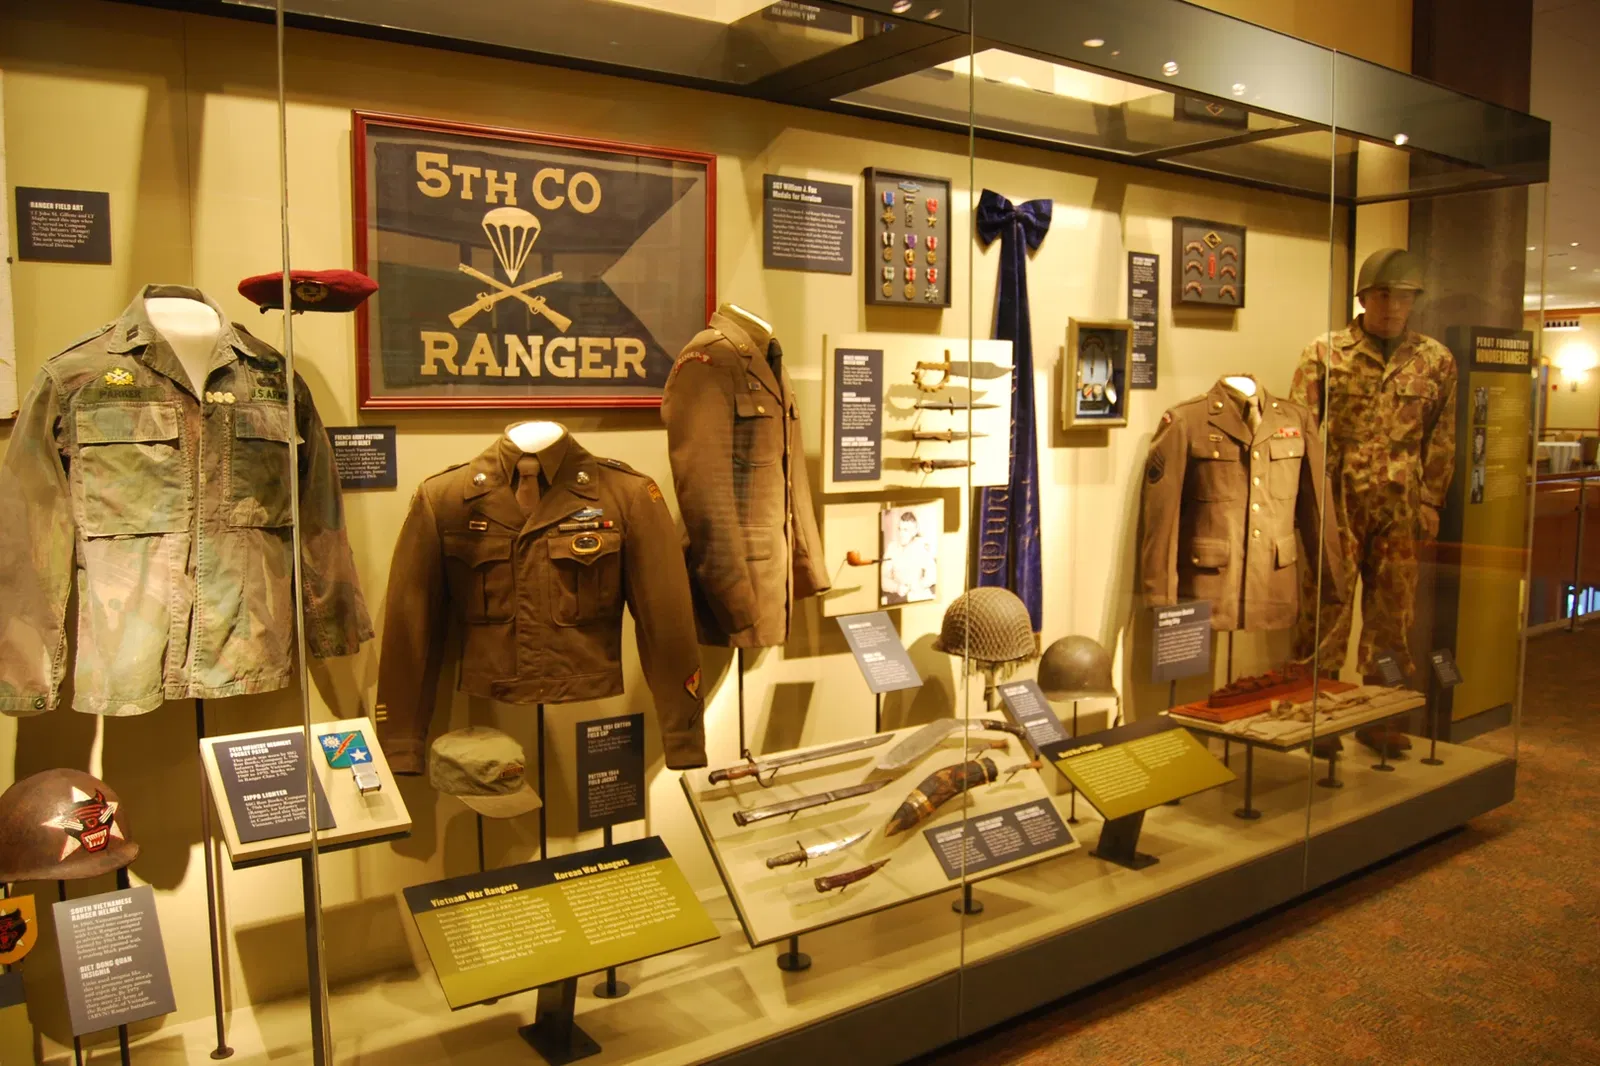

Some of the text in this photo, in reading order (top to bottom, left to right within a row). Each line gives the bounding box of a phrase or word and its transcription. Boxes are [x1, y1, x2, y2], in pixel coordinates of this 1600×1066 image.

[416, 151, 602, 214] 5TH CO
[420, 331, 647, 379] RANGER
[262, 790, 288, 798] LIGHTER
[554, 858, 631, 880] Korean War Rangers
[431, 882, 519, 908] Vietnam War Rangers
[70, 897, 133, 915] SOUTH VIETNAMESE
[72, 906, 123, 921] RANGER HELMET
[96, 960, 114, 969] DONG
[114, 956, 132, 965] QUAN
[81, 968, 110, 979] INSIGNIA
